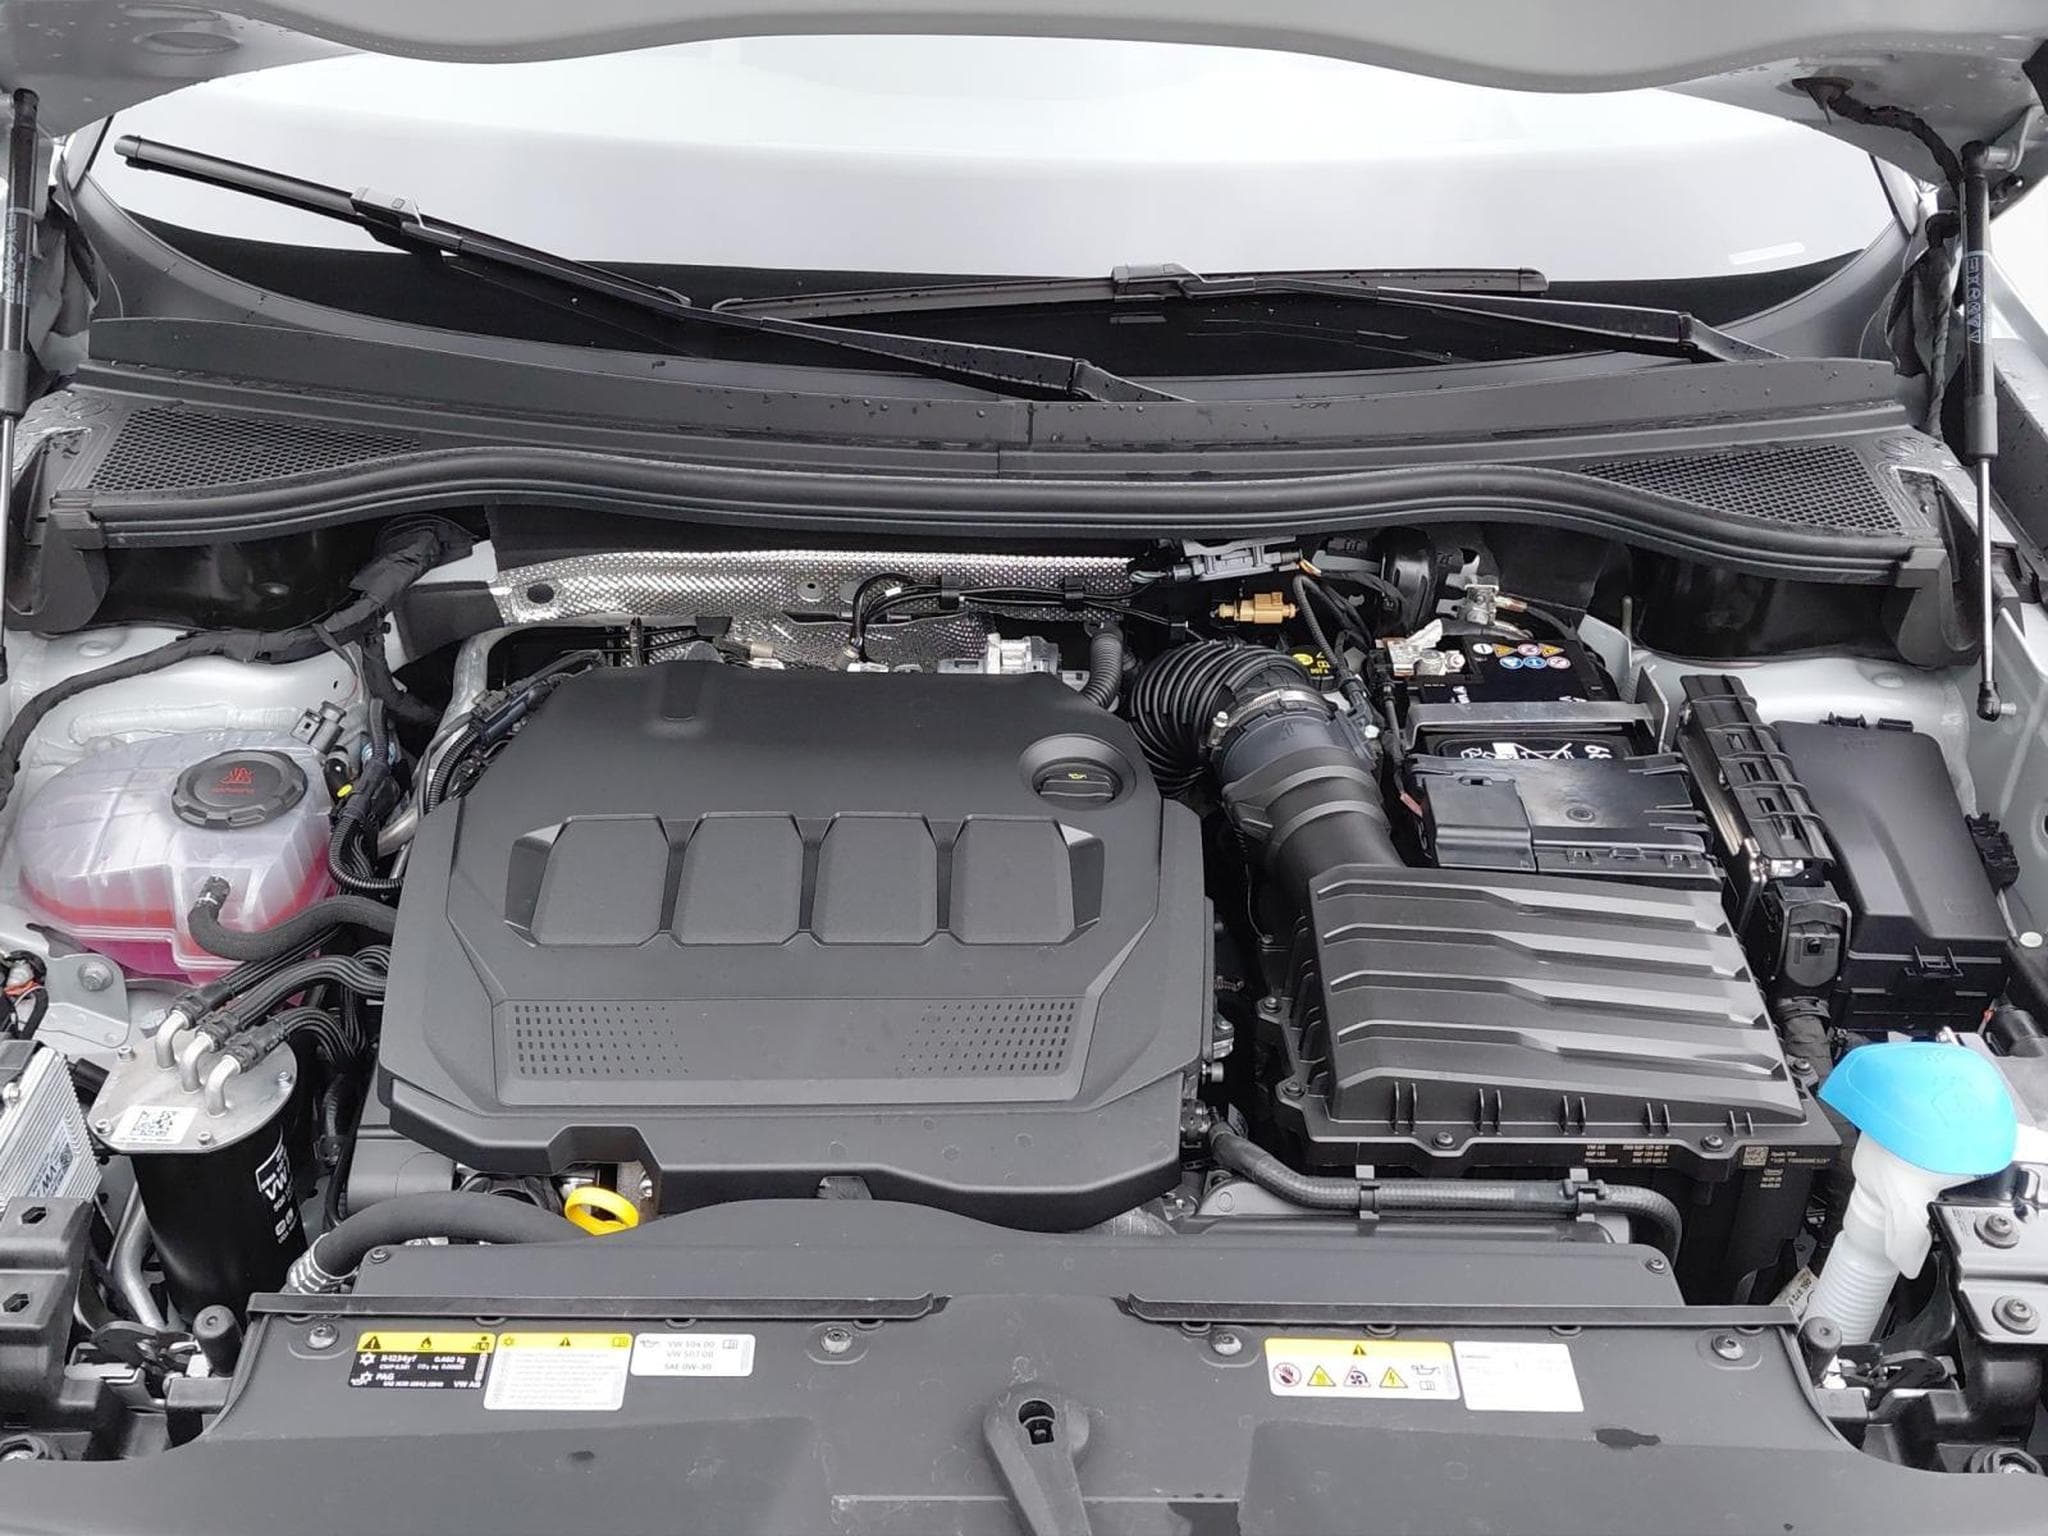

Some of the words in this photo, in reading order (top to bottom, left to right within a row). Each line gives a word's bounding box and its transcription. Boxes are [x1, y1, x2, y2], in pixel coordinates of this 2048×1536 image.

[265, 1166, 287, 1200] VW
[667, 1340, 684, 1348] VW
[666, 1350, 682, 1358] VW
[375, 1371, 395, 1381] PAG
[453, 1380, 468, 1388] VW
